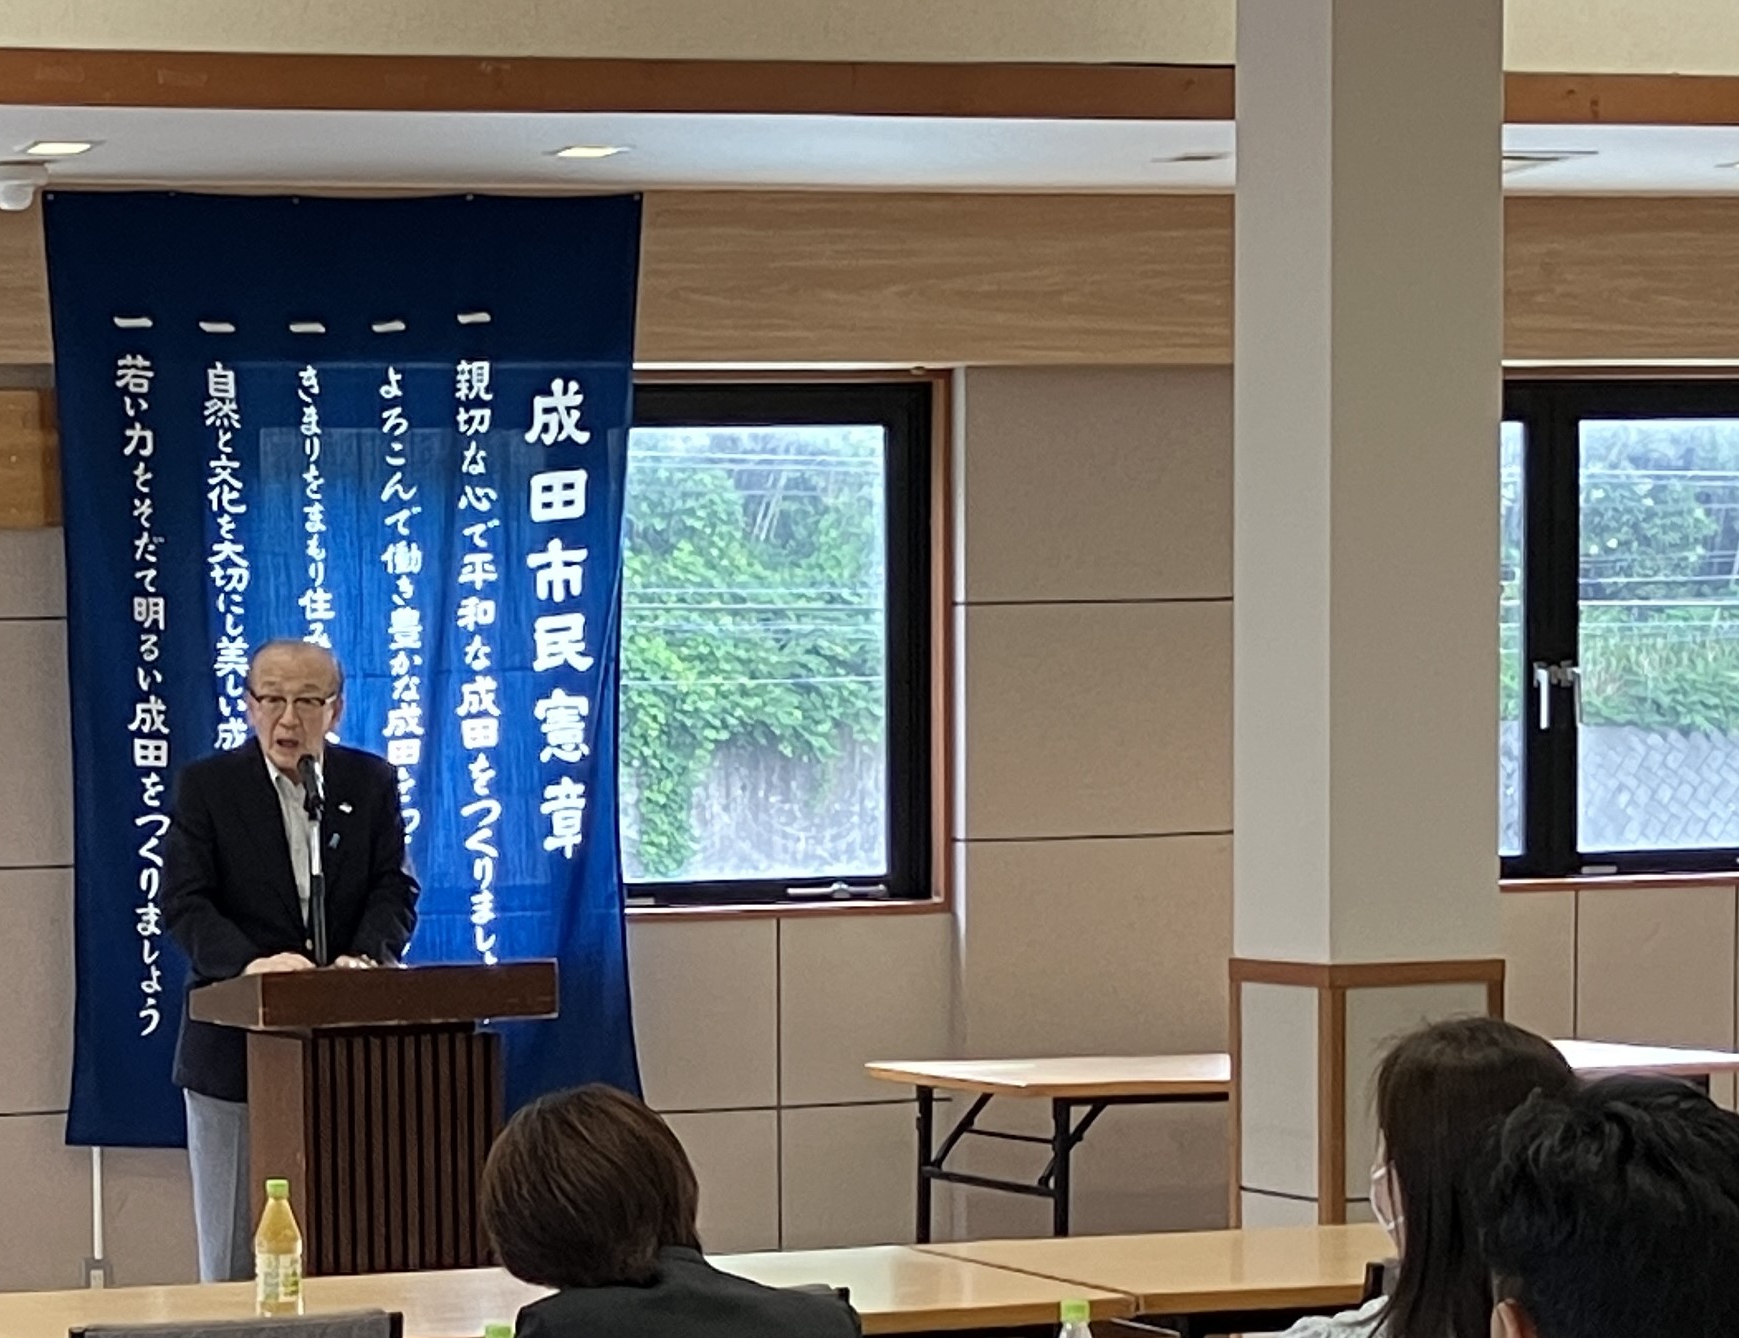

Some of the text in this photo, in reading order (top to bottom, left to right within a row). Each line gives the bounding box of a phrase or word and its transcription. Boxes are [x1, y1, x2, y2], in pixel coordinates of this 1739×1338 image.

[115, 354, 172, 1037] 若い力をそだて明るい成田をつくりましょう
[378, 365, 425, 845] よろこんで働き豊かな成田をつ
[524, 378, 595, 859] 成田市民憲章
